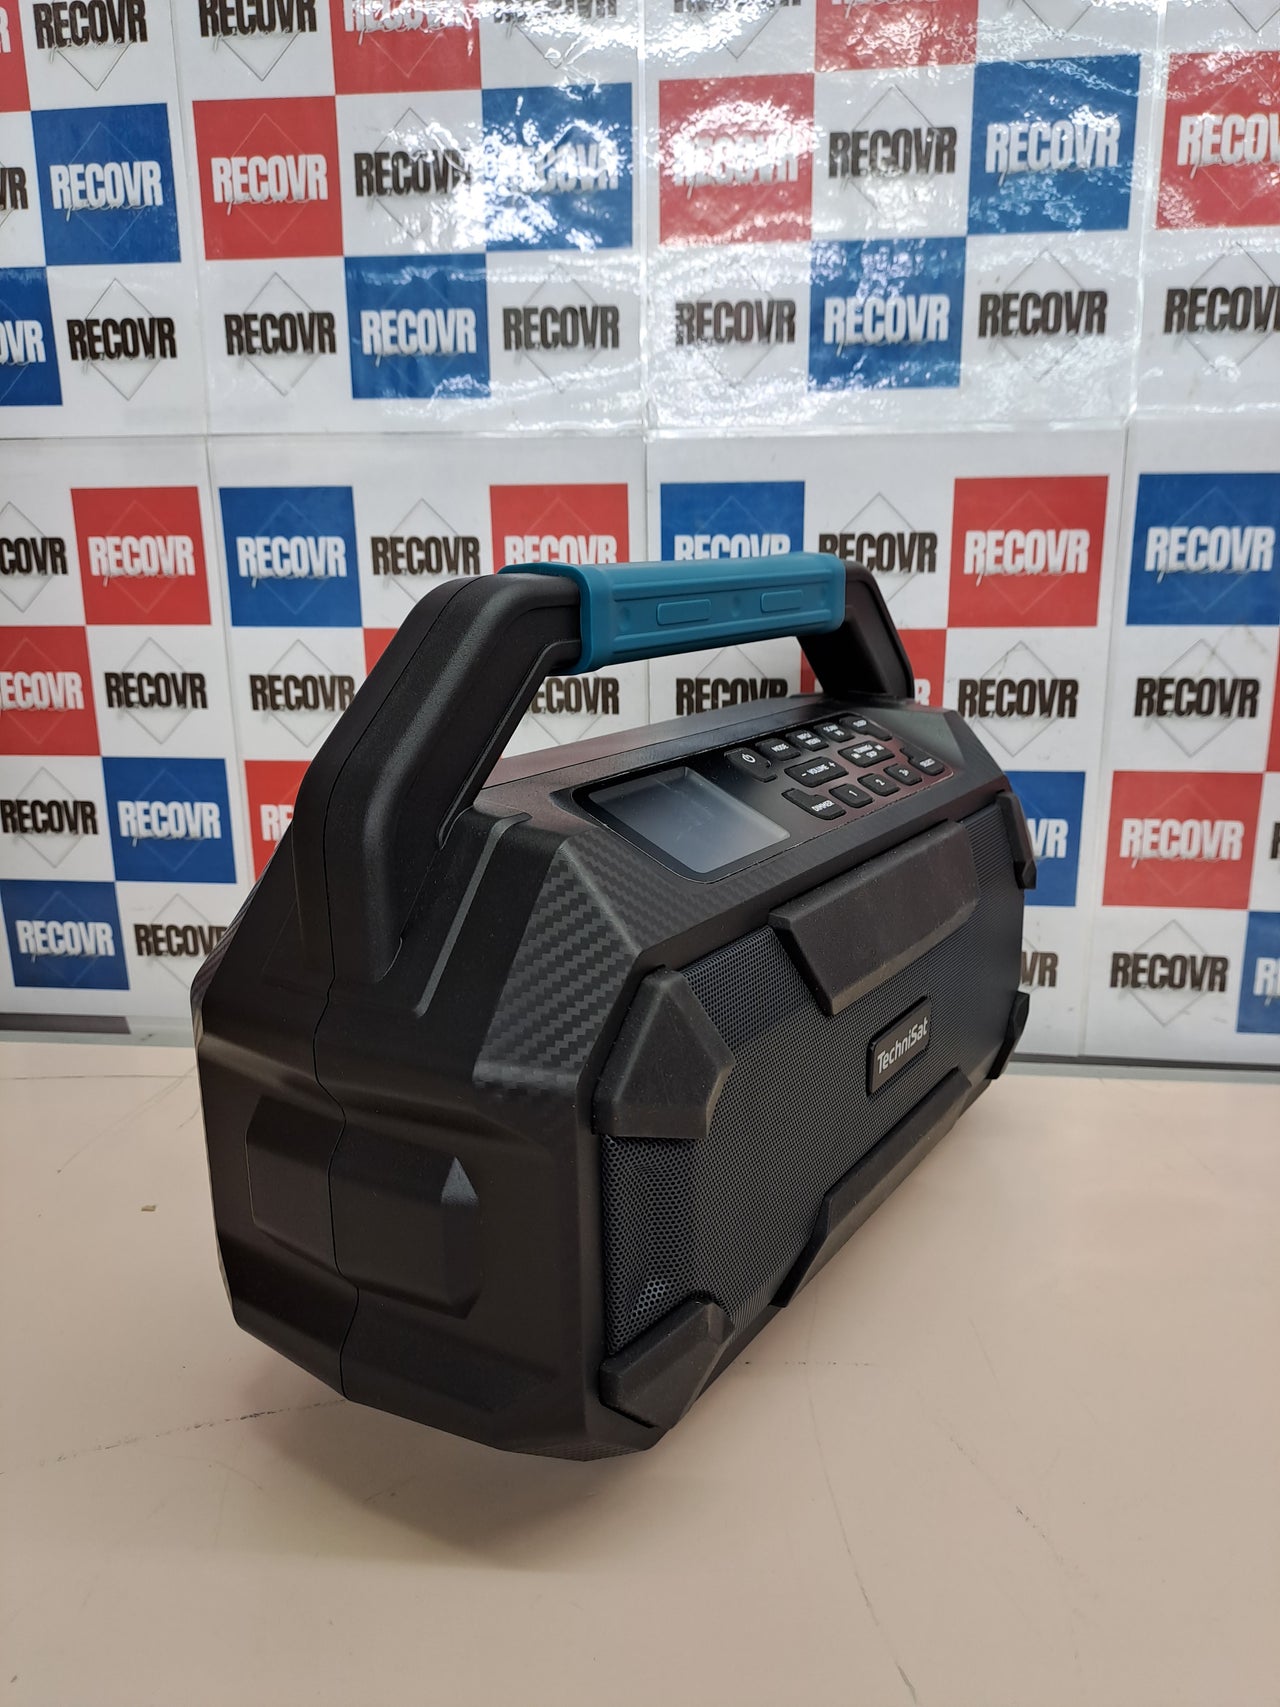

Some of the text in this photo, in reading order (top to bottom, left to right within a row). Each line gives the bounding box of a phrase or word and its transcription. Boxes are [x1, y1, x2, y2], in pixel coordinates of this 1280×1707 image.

[33, 0, 148, 49] RECOVR
[199, 0, 318, 37] RECOVR
[828, 127, 957, 179] RECOVR
[985, 118, 1121, 174] RECOVR
[50, 161, 163, 209] RECOVR
[211, 154, 328, 204] RECOVR
[224, 310, 336, 356] RECOVR
[360, 307, 477, 356] RECOVR
[503, 305, 620, 351] RECOVR
[675, 299, 796, 346] RECOVR
[823, 294, 950, 346] RECOVR
[978, 290, 1108, 338] RECOVR
[66, 317, 177, 361] RECOVR
[87, 535, 196, 577] RECOVR
[236, 536, 348, 578] RECOVR
[371, 535, 480, 575] RECOVR
[504, 534, 618, 564] RECOVR
[819, 532, 938, 573] RECOVR
[963, 529, 1090, 574] RECOVR
[1145, 526, 1275, 572] RECOVR
[0, 671, 84, 710] ECOVR
[104, 673, 208, 709] RECOVR
[249, 675, 356, 711] RECOVR
[527, 676, 620, 715] ECOVR
[958, 678, 1079, 718] RECOVR
[1134, 677, 1260, 718] RECOVR
[848, 789, 858, 797] 1
[875, 778, 885, 786] 2
[1, 800, 98, 834] RECOVR
[118, 801, 222, 839] RECOVR
[1120, 818, 1244, 860] RECOVR
[15, 920, 115, 956] RECOVR
[1110, 952, 1229, 992] RECOVR
[877, 1016, 928, 1074] TechniSat
